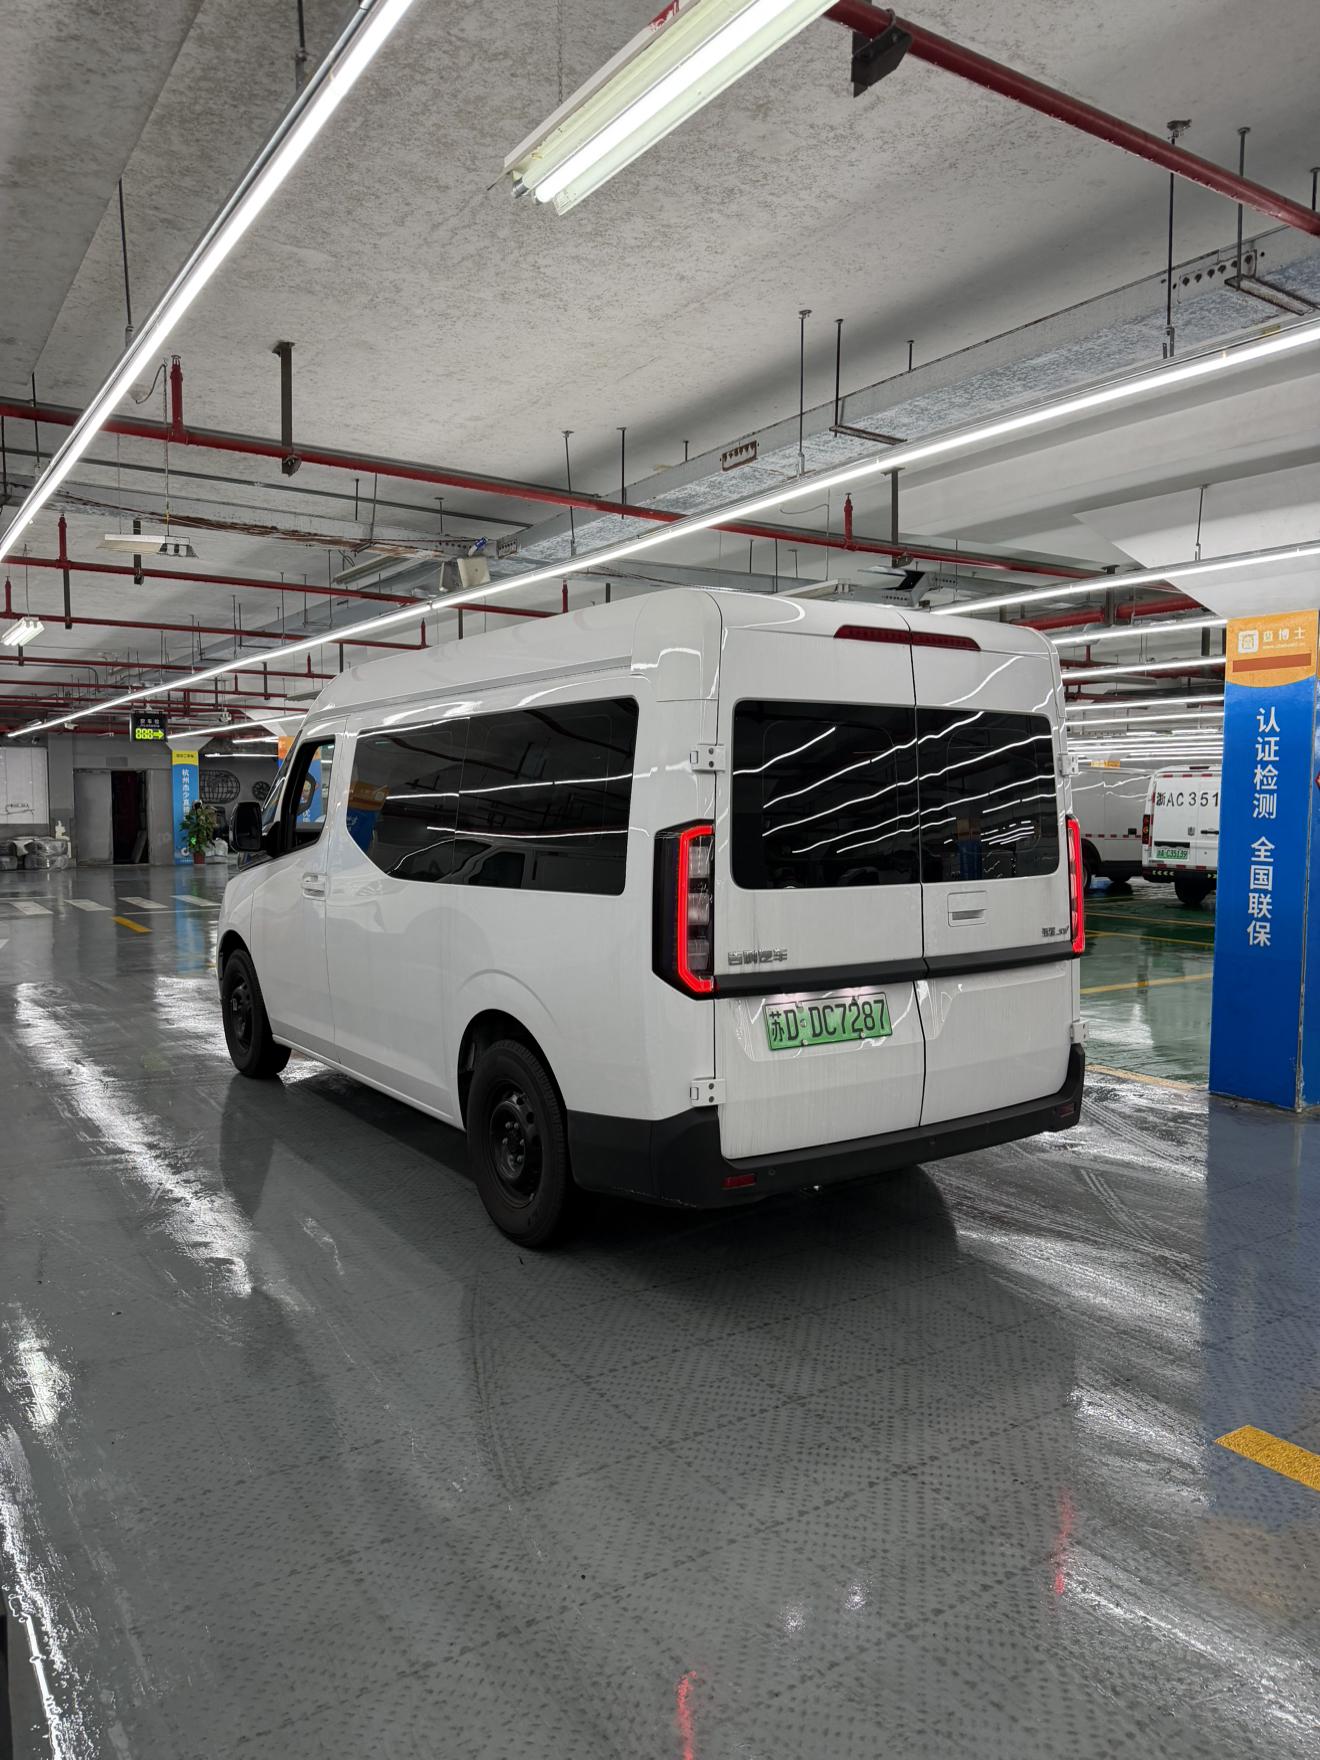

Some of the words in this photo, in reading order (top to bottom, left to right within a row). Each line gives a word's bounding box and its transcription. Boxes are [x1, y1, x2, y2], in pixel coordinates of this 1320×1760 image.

[1252, 706, 1281, 820] 认证检测
[1247, 836, 1275, 947] 全国联保
